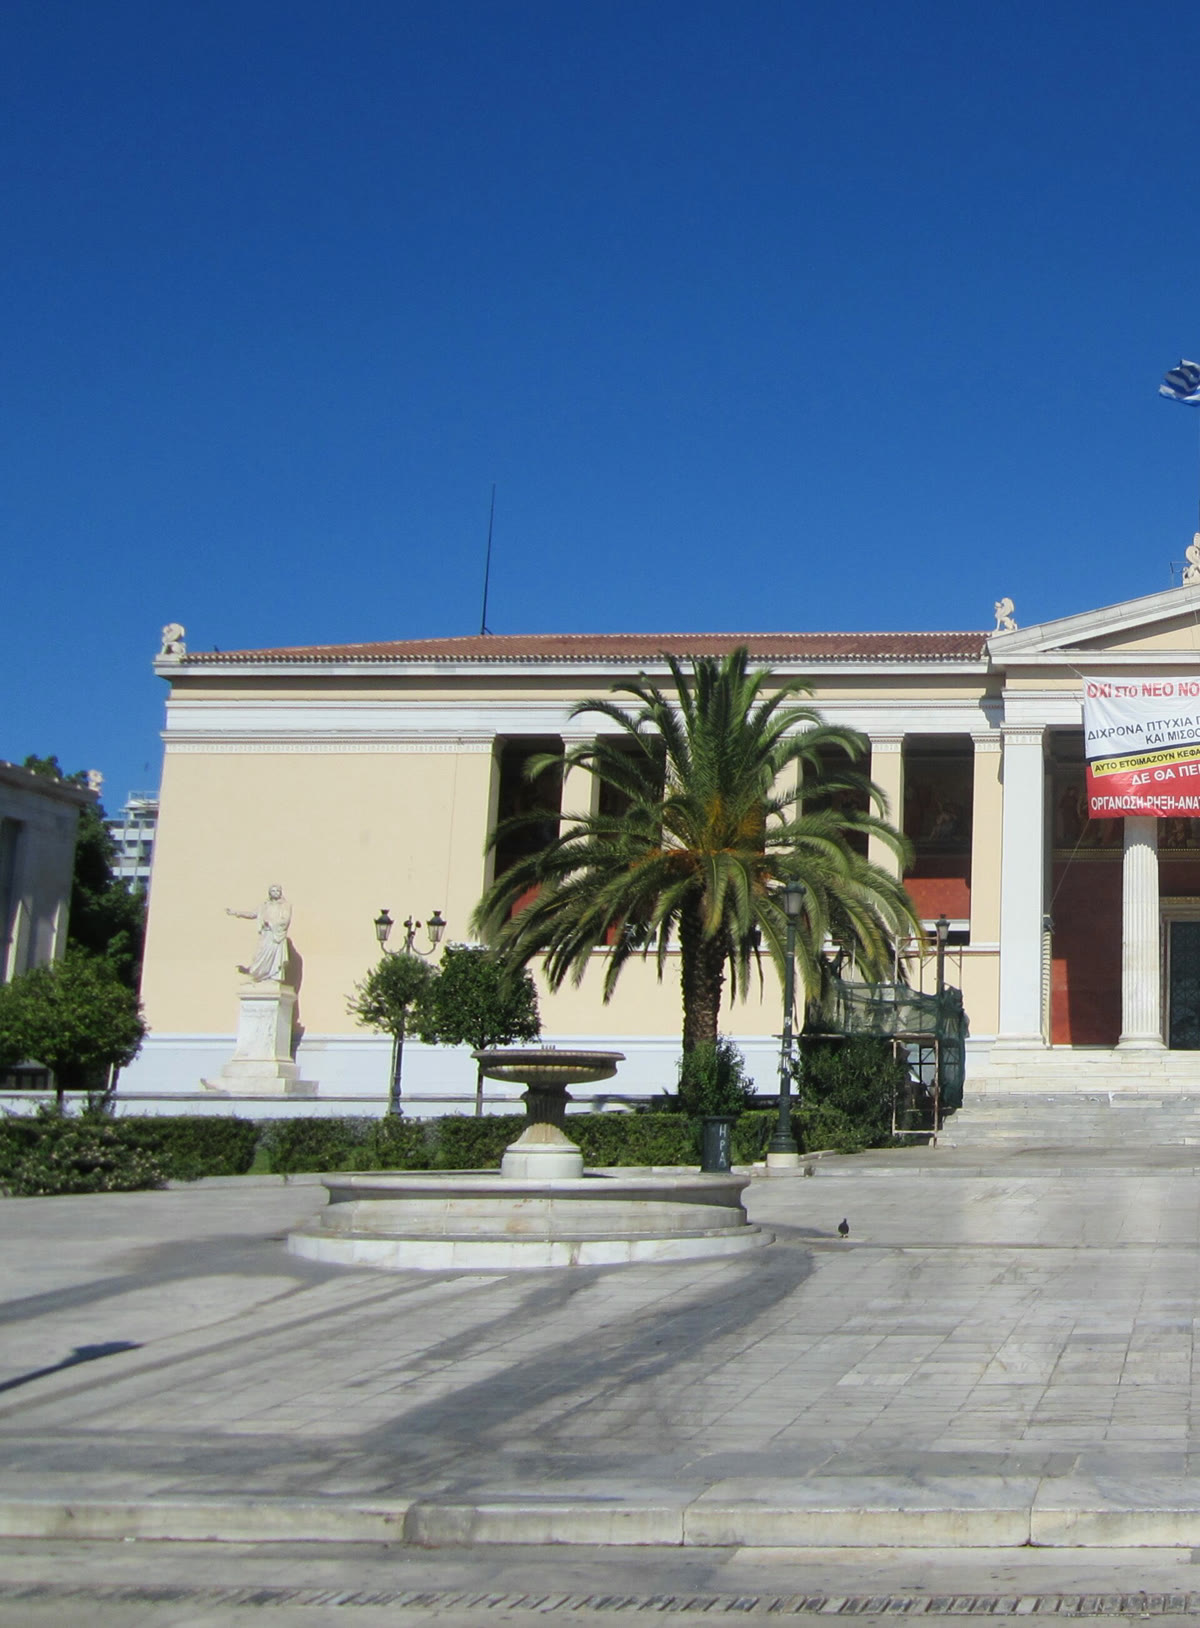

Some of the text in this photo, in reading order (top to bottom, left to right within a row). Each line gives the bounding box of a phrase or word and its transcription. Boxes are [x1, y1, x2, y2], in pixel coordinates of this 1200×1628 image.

[1087, 683, 1111, 698] ΟΧΙ
[1115, 686, 1138, 698] ΣΤΟ
[1142, 682, 1174, 697] ΝΕΟ
[1088, 724, 1143, 740] ΔΙΧΡΟΝΑ
[1147, 716, 1193, 731] ΠΤΥΧΙΑ
[1145, 732, 1165, 745] ΚΑΙ
[1095, 762, 1117, 772] ΑΥΤΟ
[1120, 753, 1175, 768] ΕΤΟΙΜΑΖΟΥΝ
[1132, 773, 1151, 785] ΔΕ
[1154, 769, 1176, 781] ΘΑ
